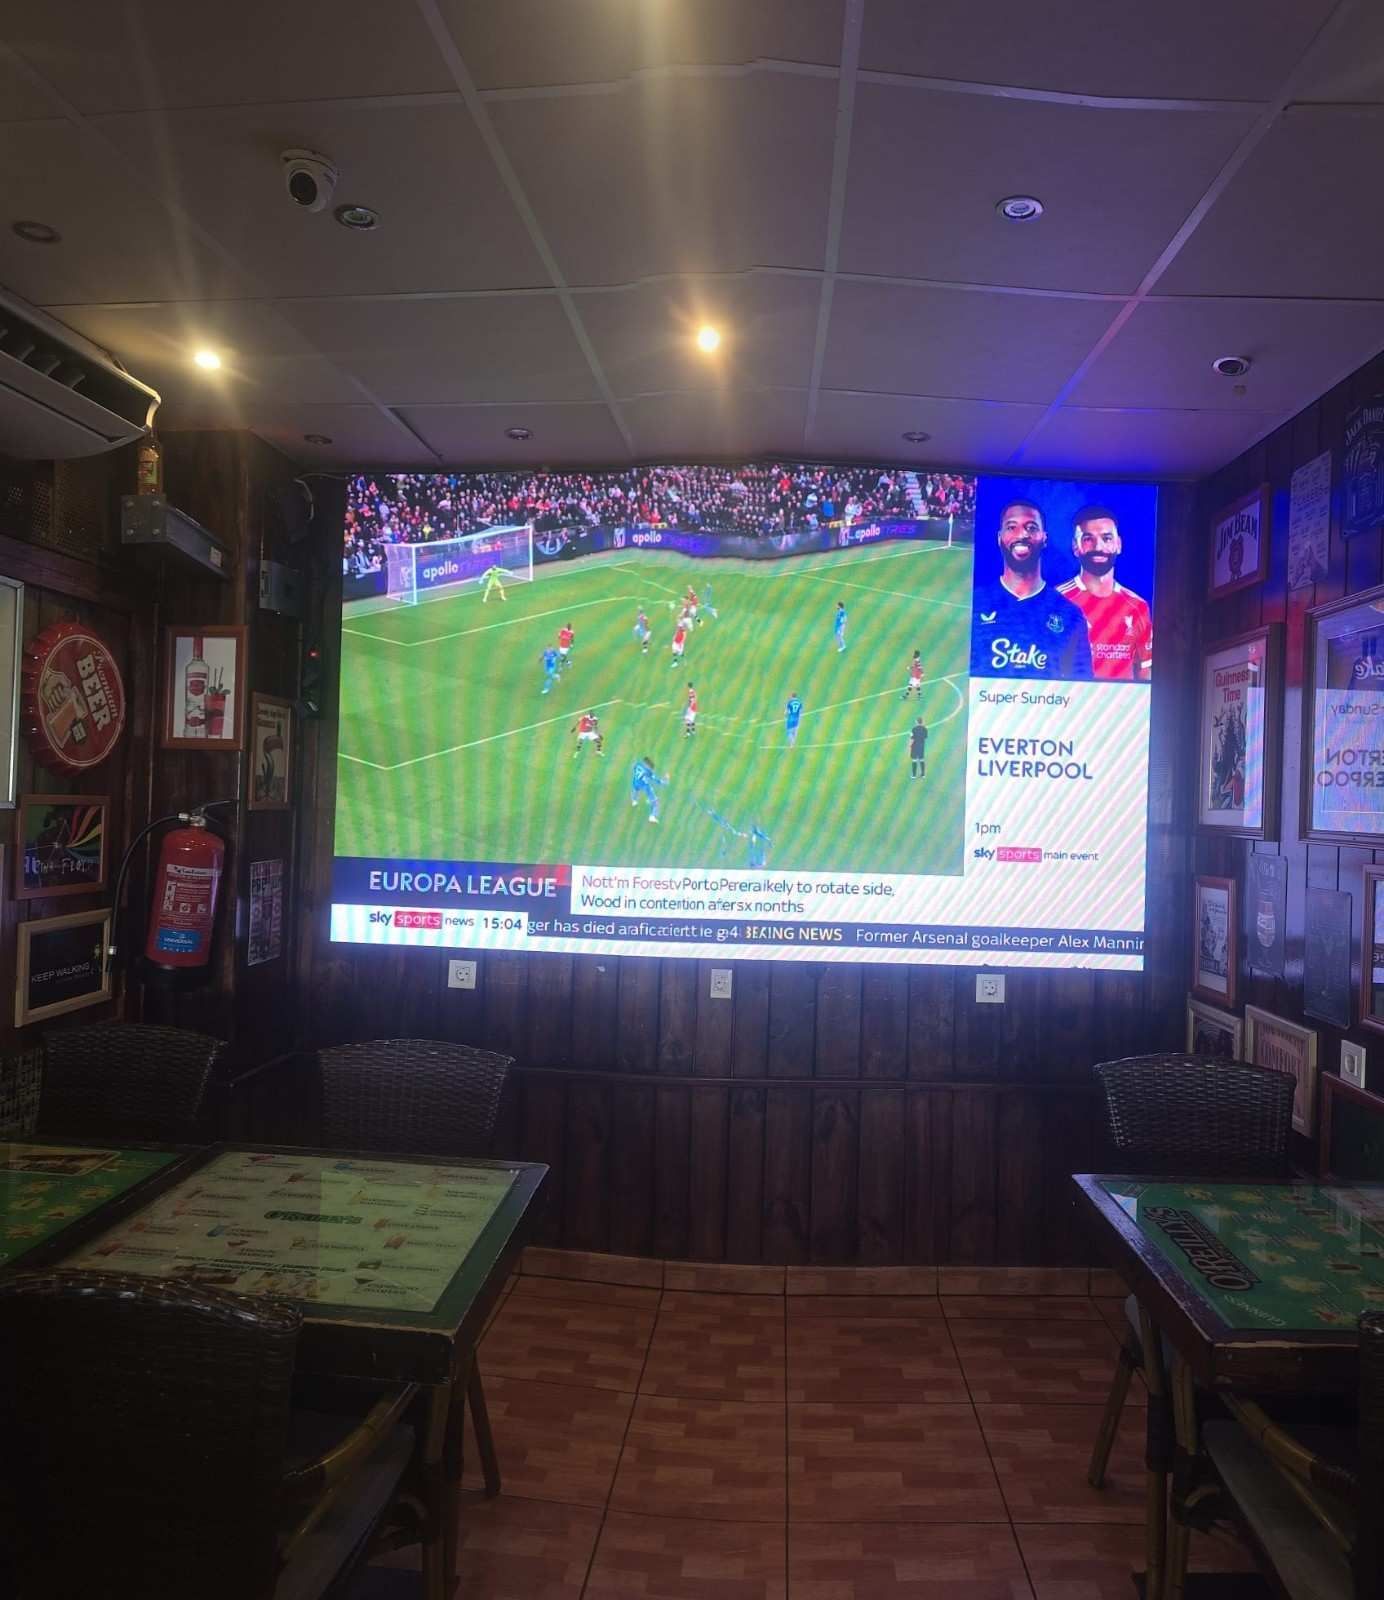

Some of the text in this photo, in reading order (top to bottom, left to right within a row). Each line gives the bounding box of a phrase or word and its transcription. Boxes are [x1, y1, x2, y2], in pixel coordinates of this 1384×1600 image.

[632, 532, 661, 550] apollo
[1216, 511, 1258, 560] JIM BEAM
[423, 561, 459, 580] apollo
[991, 638, 1048, 669] Stake
[1215, 669, 1249, 687] Guinness
[77, 653, 113, 732] BEER
[979, 690, 1070, 708] Super Sunday
[1222, 687, 1241, 703] Time
[978, 737, 1073, 757] EVERTON
[978, 759, 1093, 780] LIVERPOOL
[975, 822, 1001, 836] 1pm
[974, 847, 1099, 862] sky sports main event
[369, 871, 557, 898] EUROPA LEAGUE
[582, 875, 630, 889] Nott'm
[797, 882, 812, 894] to
[815, 882, 860, 895] rotate
[863, 883, 895, 896] side,
[581, 894, 621, 908] Wood
[624, 895, 637, 908] in
[369, 910, 523, 930] sky sports news 15:04
[554, 919, 580, 933] has
[583, 920, 615, 935] died
[799, 927, 843, 941] NEWS
[856, 929, 908, 943] Former
[912, 930, 968, 945] Arsenal
[971, 932, 1054, 950] goalkeeper
[1058, 935, 1090, 948] Alex
[31, 970, 55, 984] KEEP
[56, 961, 90, 977] WALKING
